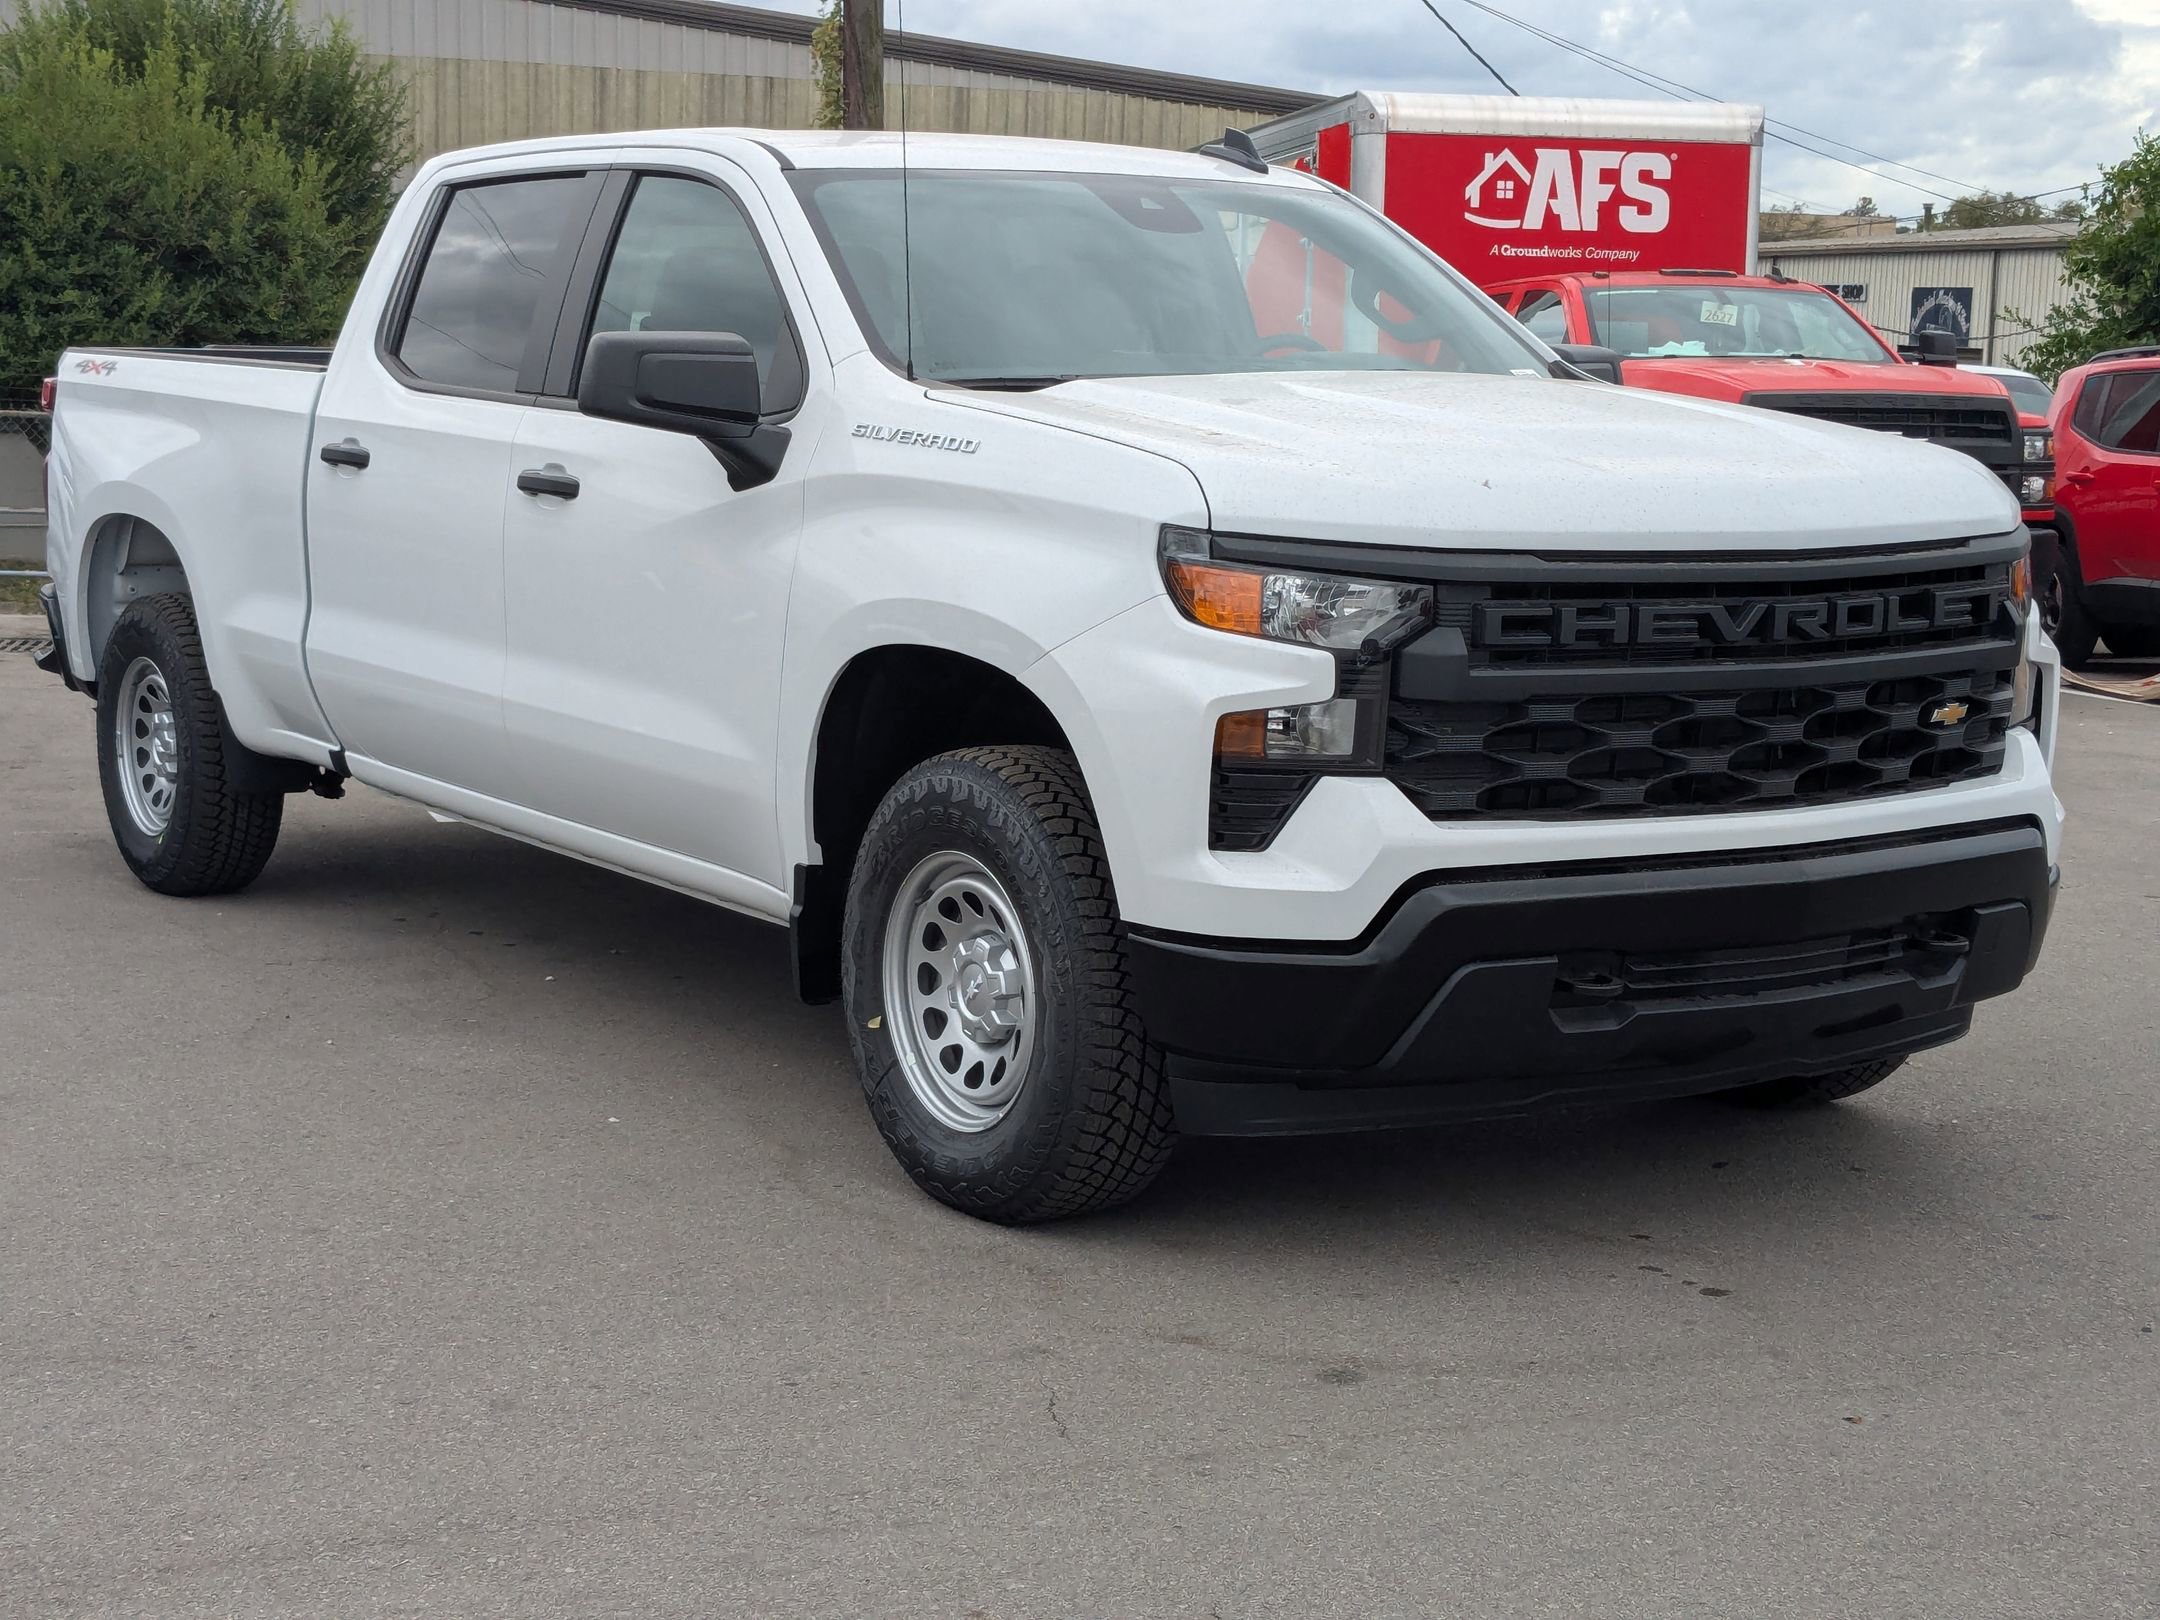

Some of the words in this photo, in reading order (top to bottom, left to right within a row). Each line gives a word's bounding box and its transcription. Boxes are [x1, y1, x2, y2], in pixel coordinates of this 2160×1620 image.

[1489, 245, 1499, 256] A
[1500, 245, 1582, 259] Groundworks
[1585, 247, 1640, 262] Company
[851, 423, 981, 454] SILVERADO
[1478, 584, 2006, 646] CHEVROLET
